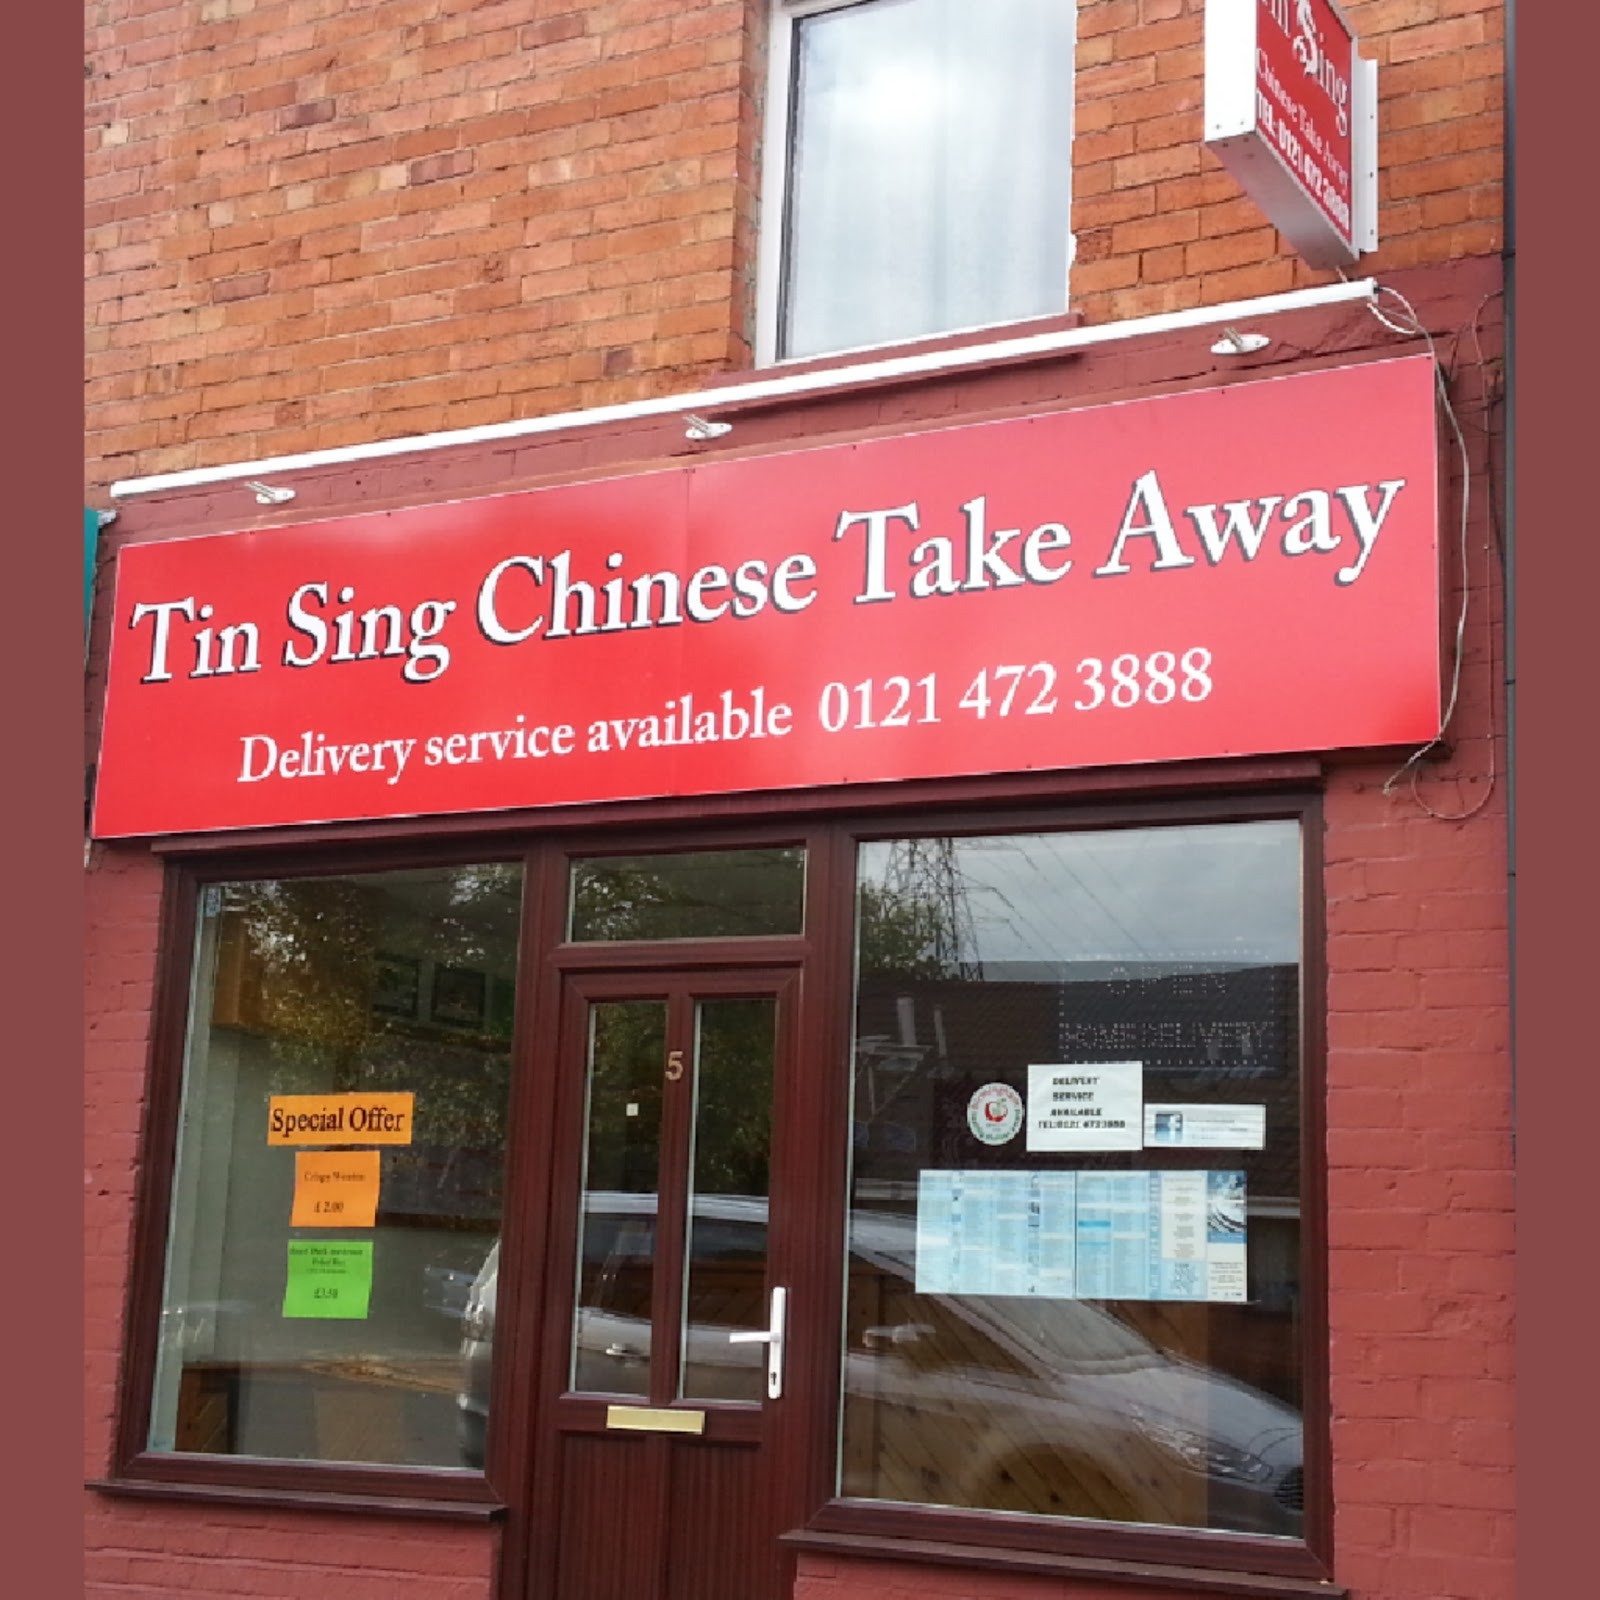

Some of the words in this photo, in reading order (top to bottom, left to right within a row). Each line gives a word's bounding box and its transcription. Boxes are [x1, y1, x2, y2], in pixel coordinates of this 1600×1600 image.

[131, 595, 262, 684] Tin
[282, 581, 457, 683] Sing
[475, 549, 818, 646] Chinese
[833, 496, 1072, 606] Take
[1093, 469, 1406, 586] Away
[237, 732, 416, 785] Delivery
[425, 715, 576, 767] service
[588, 686, 794, 753] available
[818, 673, 942, 733] 0121
[959, 660, 1058, 720] 472
[1074, 646, 1213, 711] 3888
[665, 1051, 683, 1080] 5
[270, 1106, 344, 1138] Special
[349, 1106, 406, 1132] Offer
